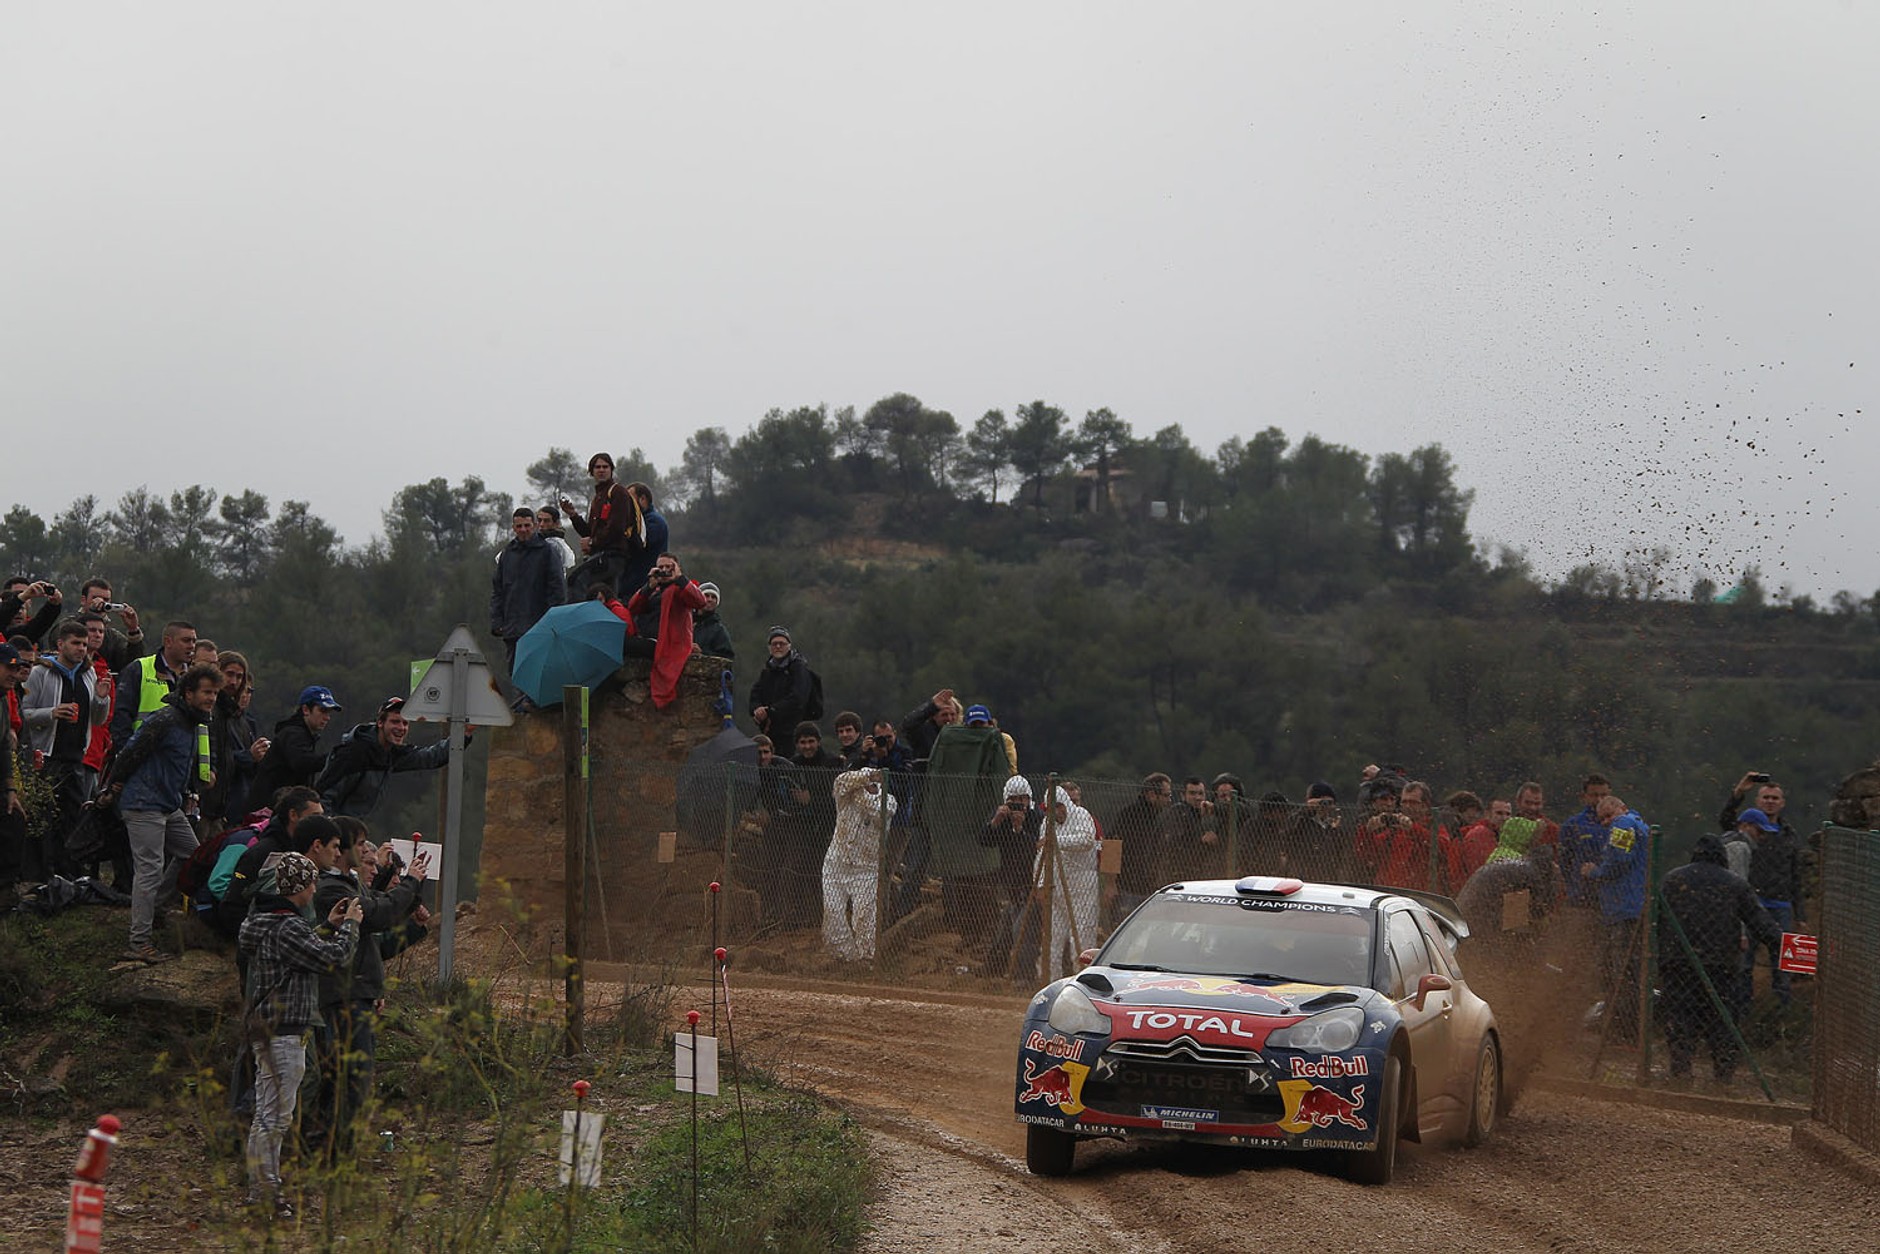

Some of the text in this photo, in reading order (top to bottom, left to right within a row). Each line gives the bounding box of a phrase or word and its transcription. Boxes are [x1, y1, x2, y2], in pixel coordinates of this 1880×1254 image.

[1187, 895, 1337, 912] WORLD CHAMPIONS
[1126, 1010, 1254, 1038] TOTAL
[1160, 1108, 1215, 1120] MICHELIN
[1083, 1124, 1127, 1135] LUHTA
